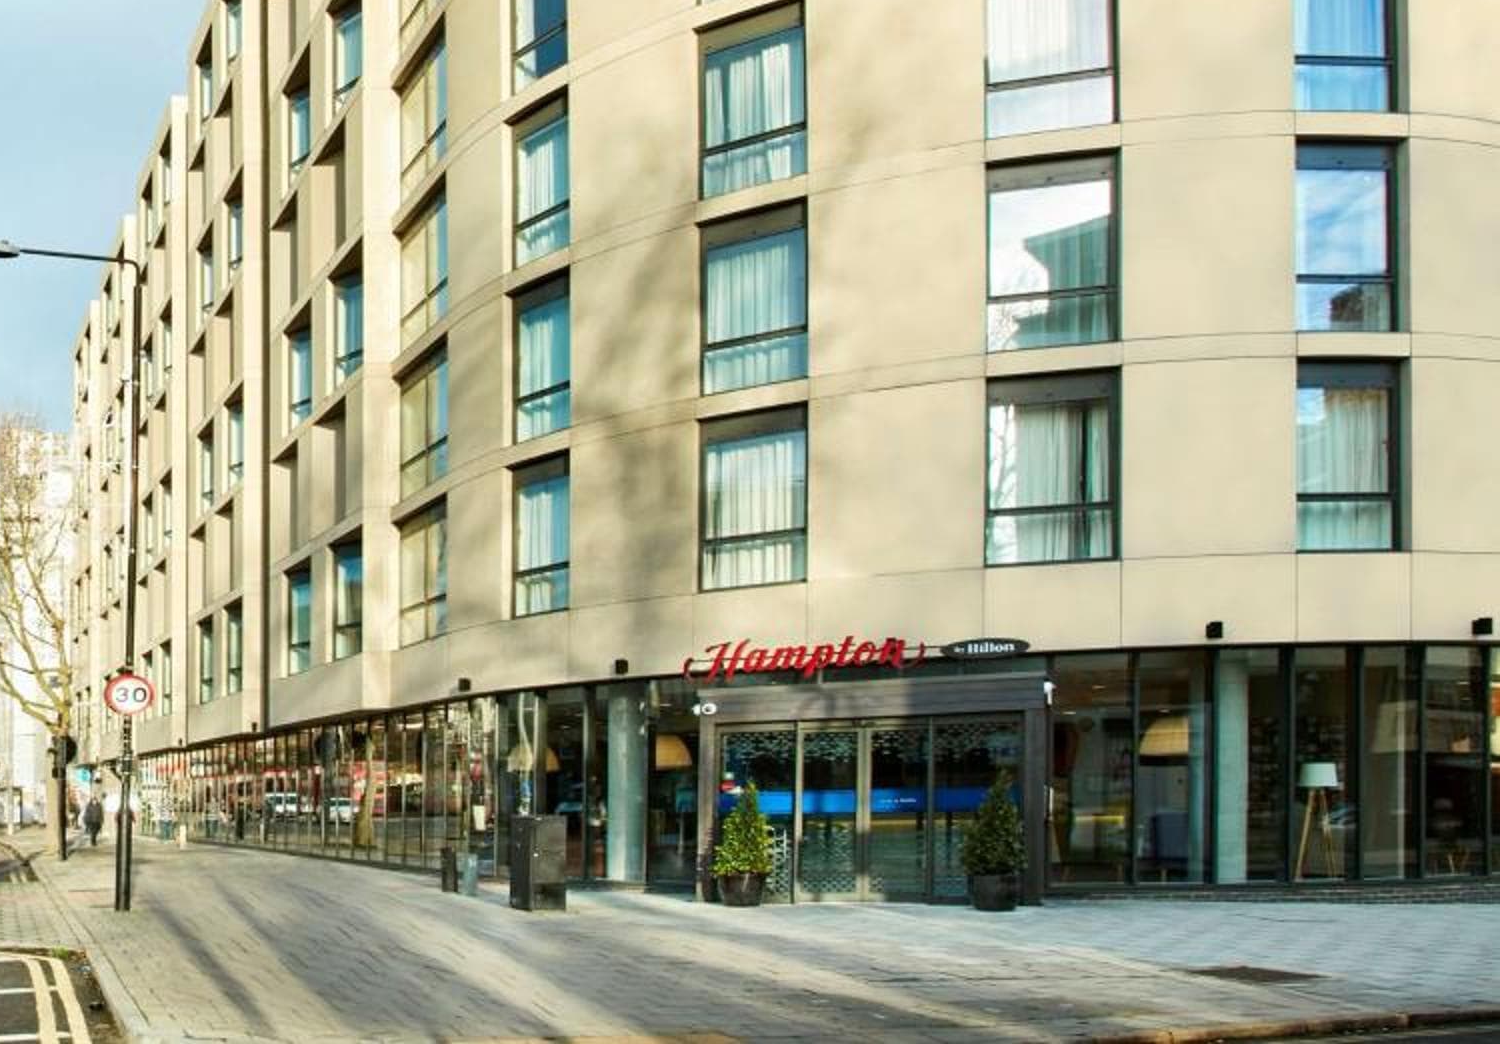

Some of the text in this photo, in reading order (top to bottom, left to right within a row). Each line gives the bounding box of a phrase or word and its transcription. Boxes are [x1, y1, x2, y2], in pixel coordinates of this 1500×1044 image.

[690, 636, 920, 683] Hampton
[967, 641, 1016, 654] Hilton
[115, 687, 147, 703] 30
